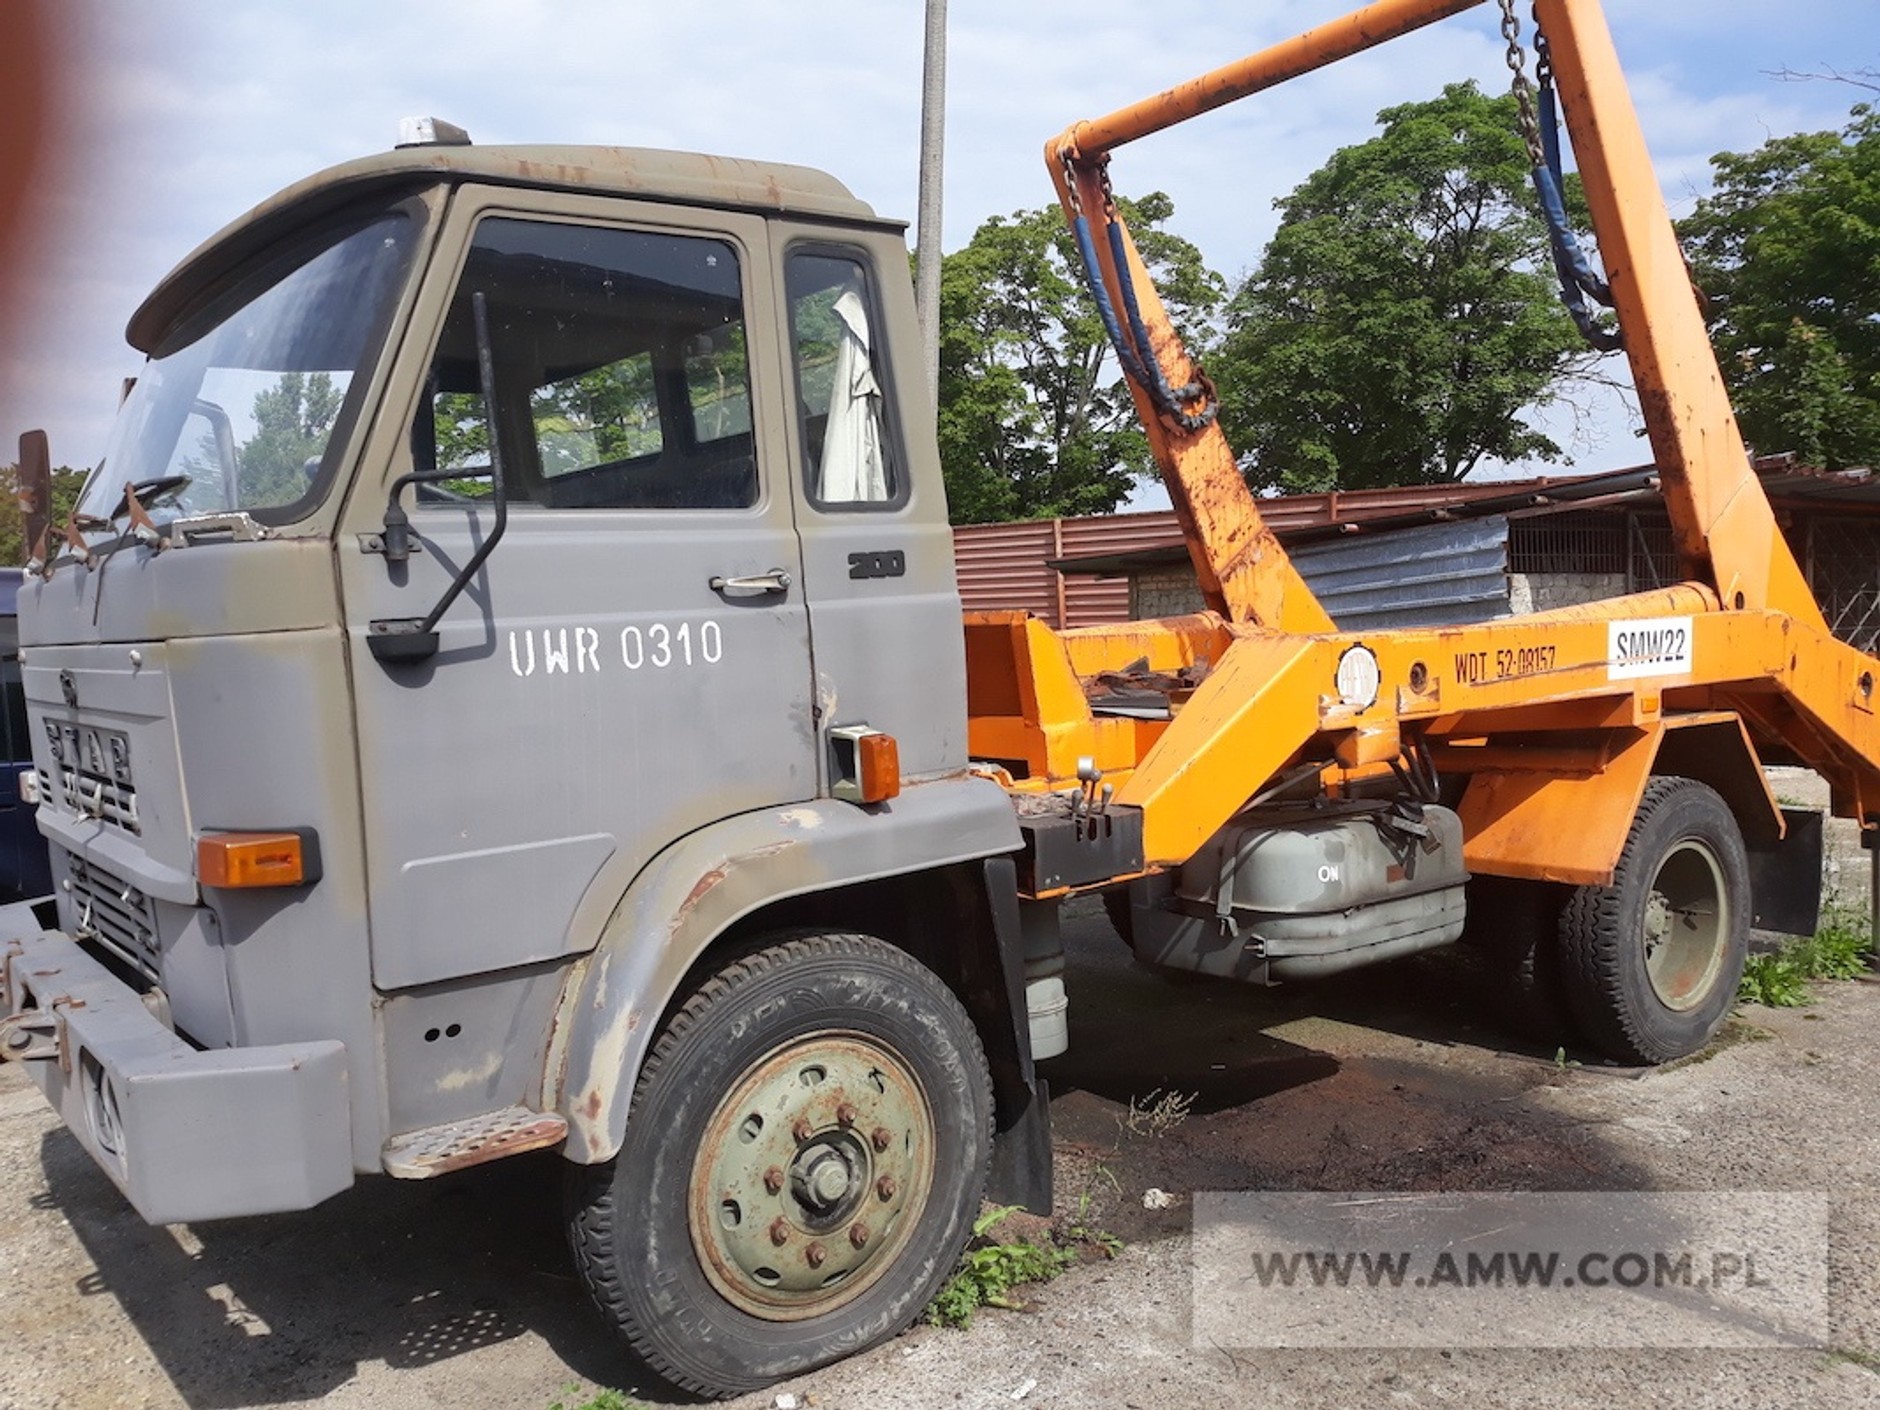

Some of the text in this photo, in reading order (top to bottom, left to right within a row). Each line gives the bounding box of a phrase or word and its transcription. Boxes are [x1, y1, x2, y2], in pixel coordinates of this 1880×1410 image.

[848, 550, 905, 579] 200
[509, 620, 723, 676] UWR 0310
[1617, 628, 1686, 667] SMW22
[1455, 652, 1487, 684] WDT
[1318, 865, 1339, 882] ON
